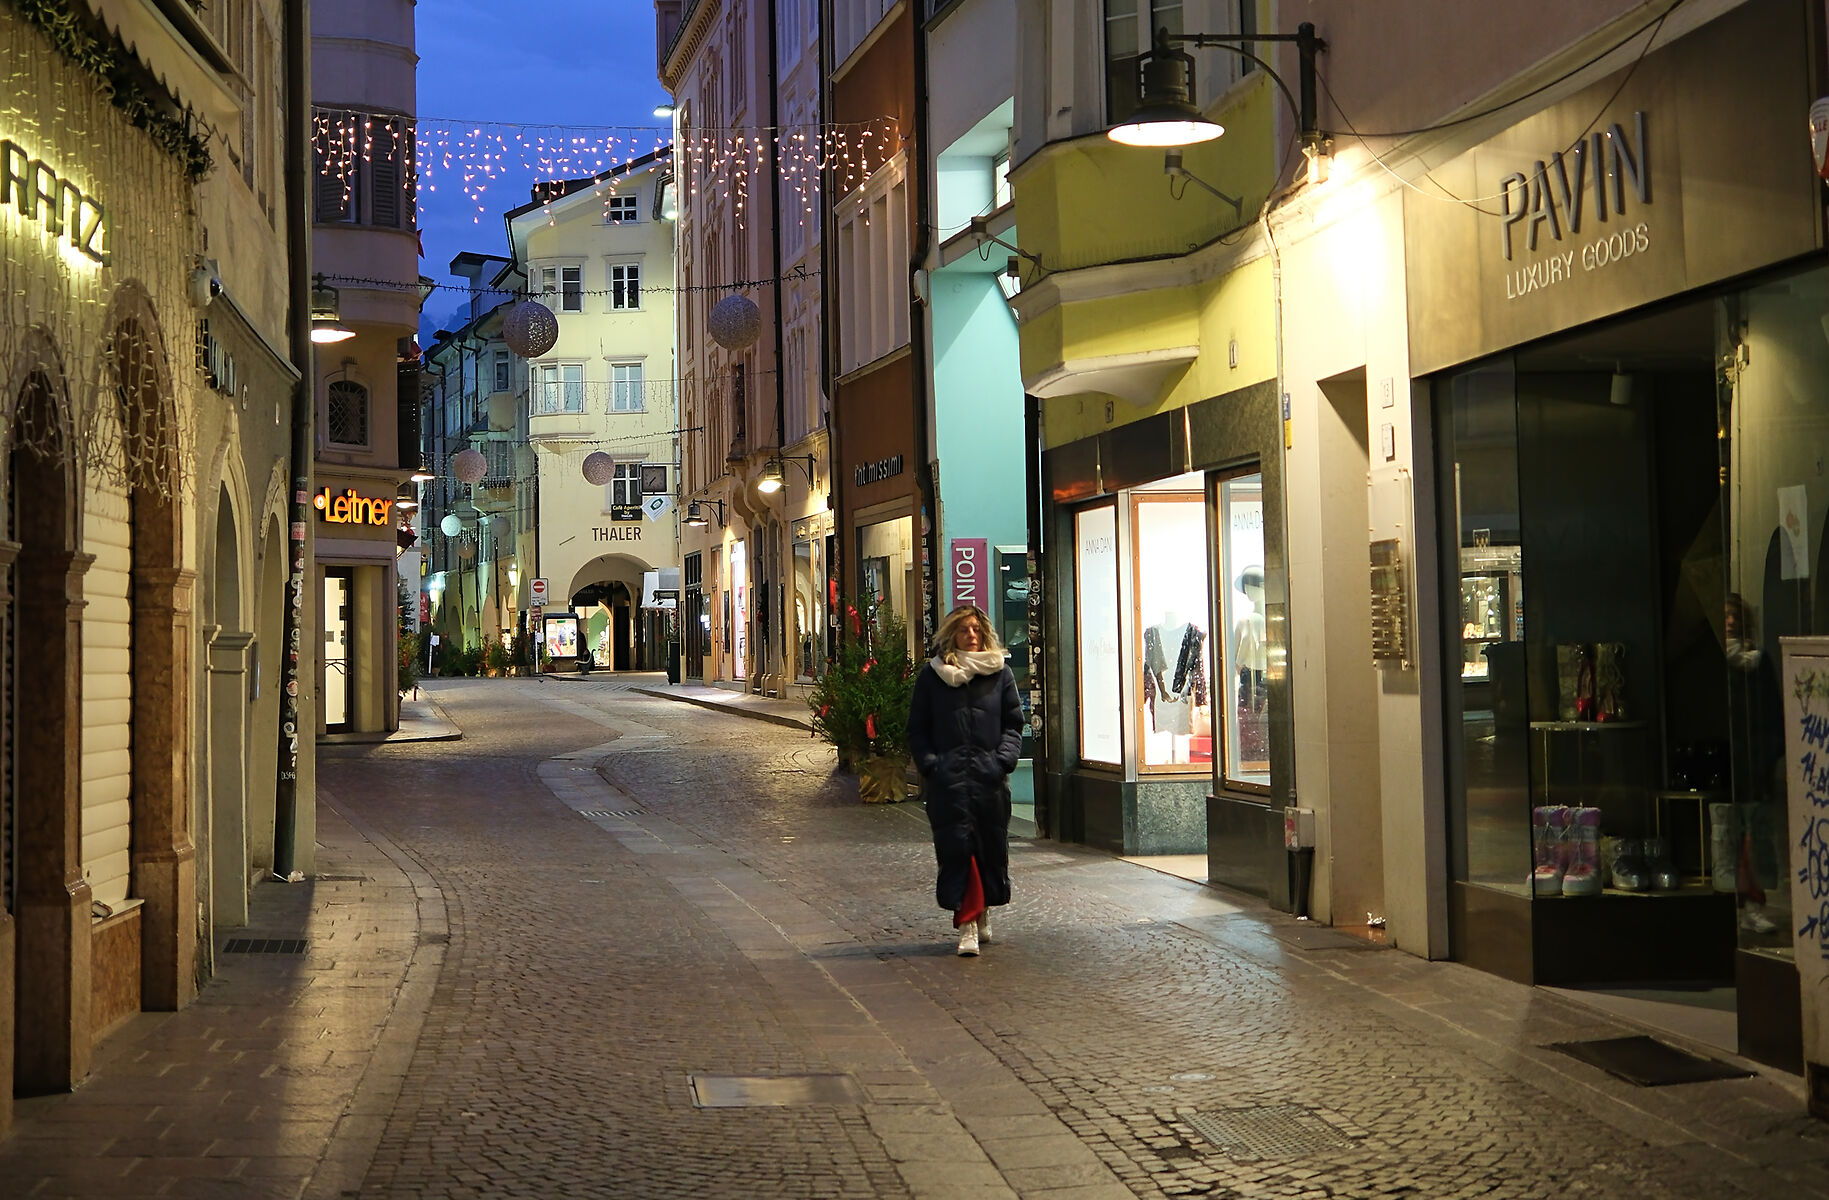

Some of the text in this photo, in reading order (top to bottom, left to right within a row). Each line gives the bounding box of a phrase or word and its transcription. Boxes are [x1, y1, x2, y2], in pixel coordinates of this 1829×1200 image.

[1500, 111, 1653, 262] PAVIN
[1507, 222, 1650, 299] LUXURY GOODS
[325, 487, 392, 526] Leitner
[592, 526, 642, 541] THALER
[956, 547, 976, 606] POIN
